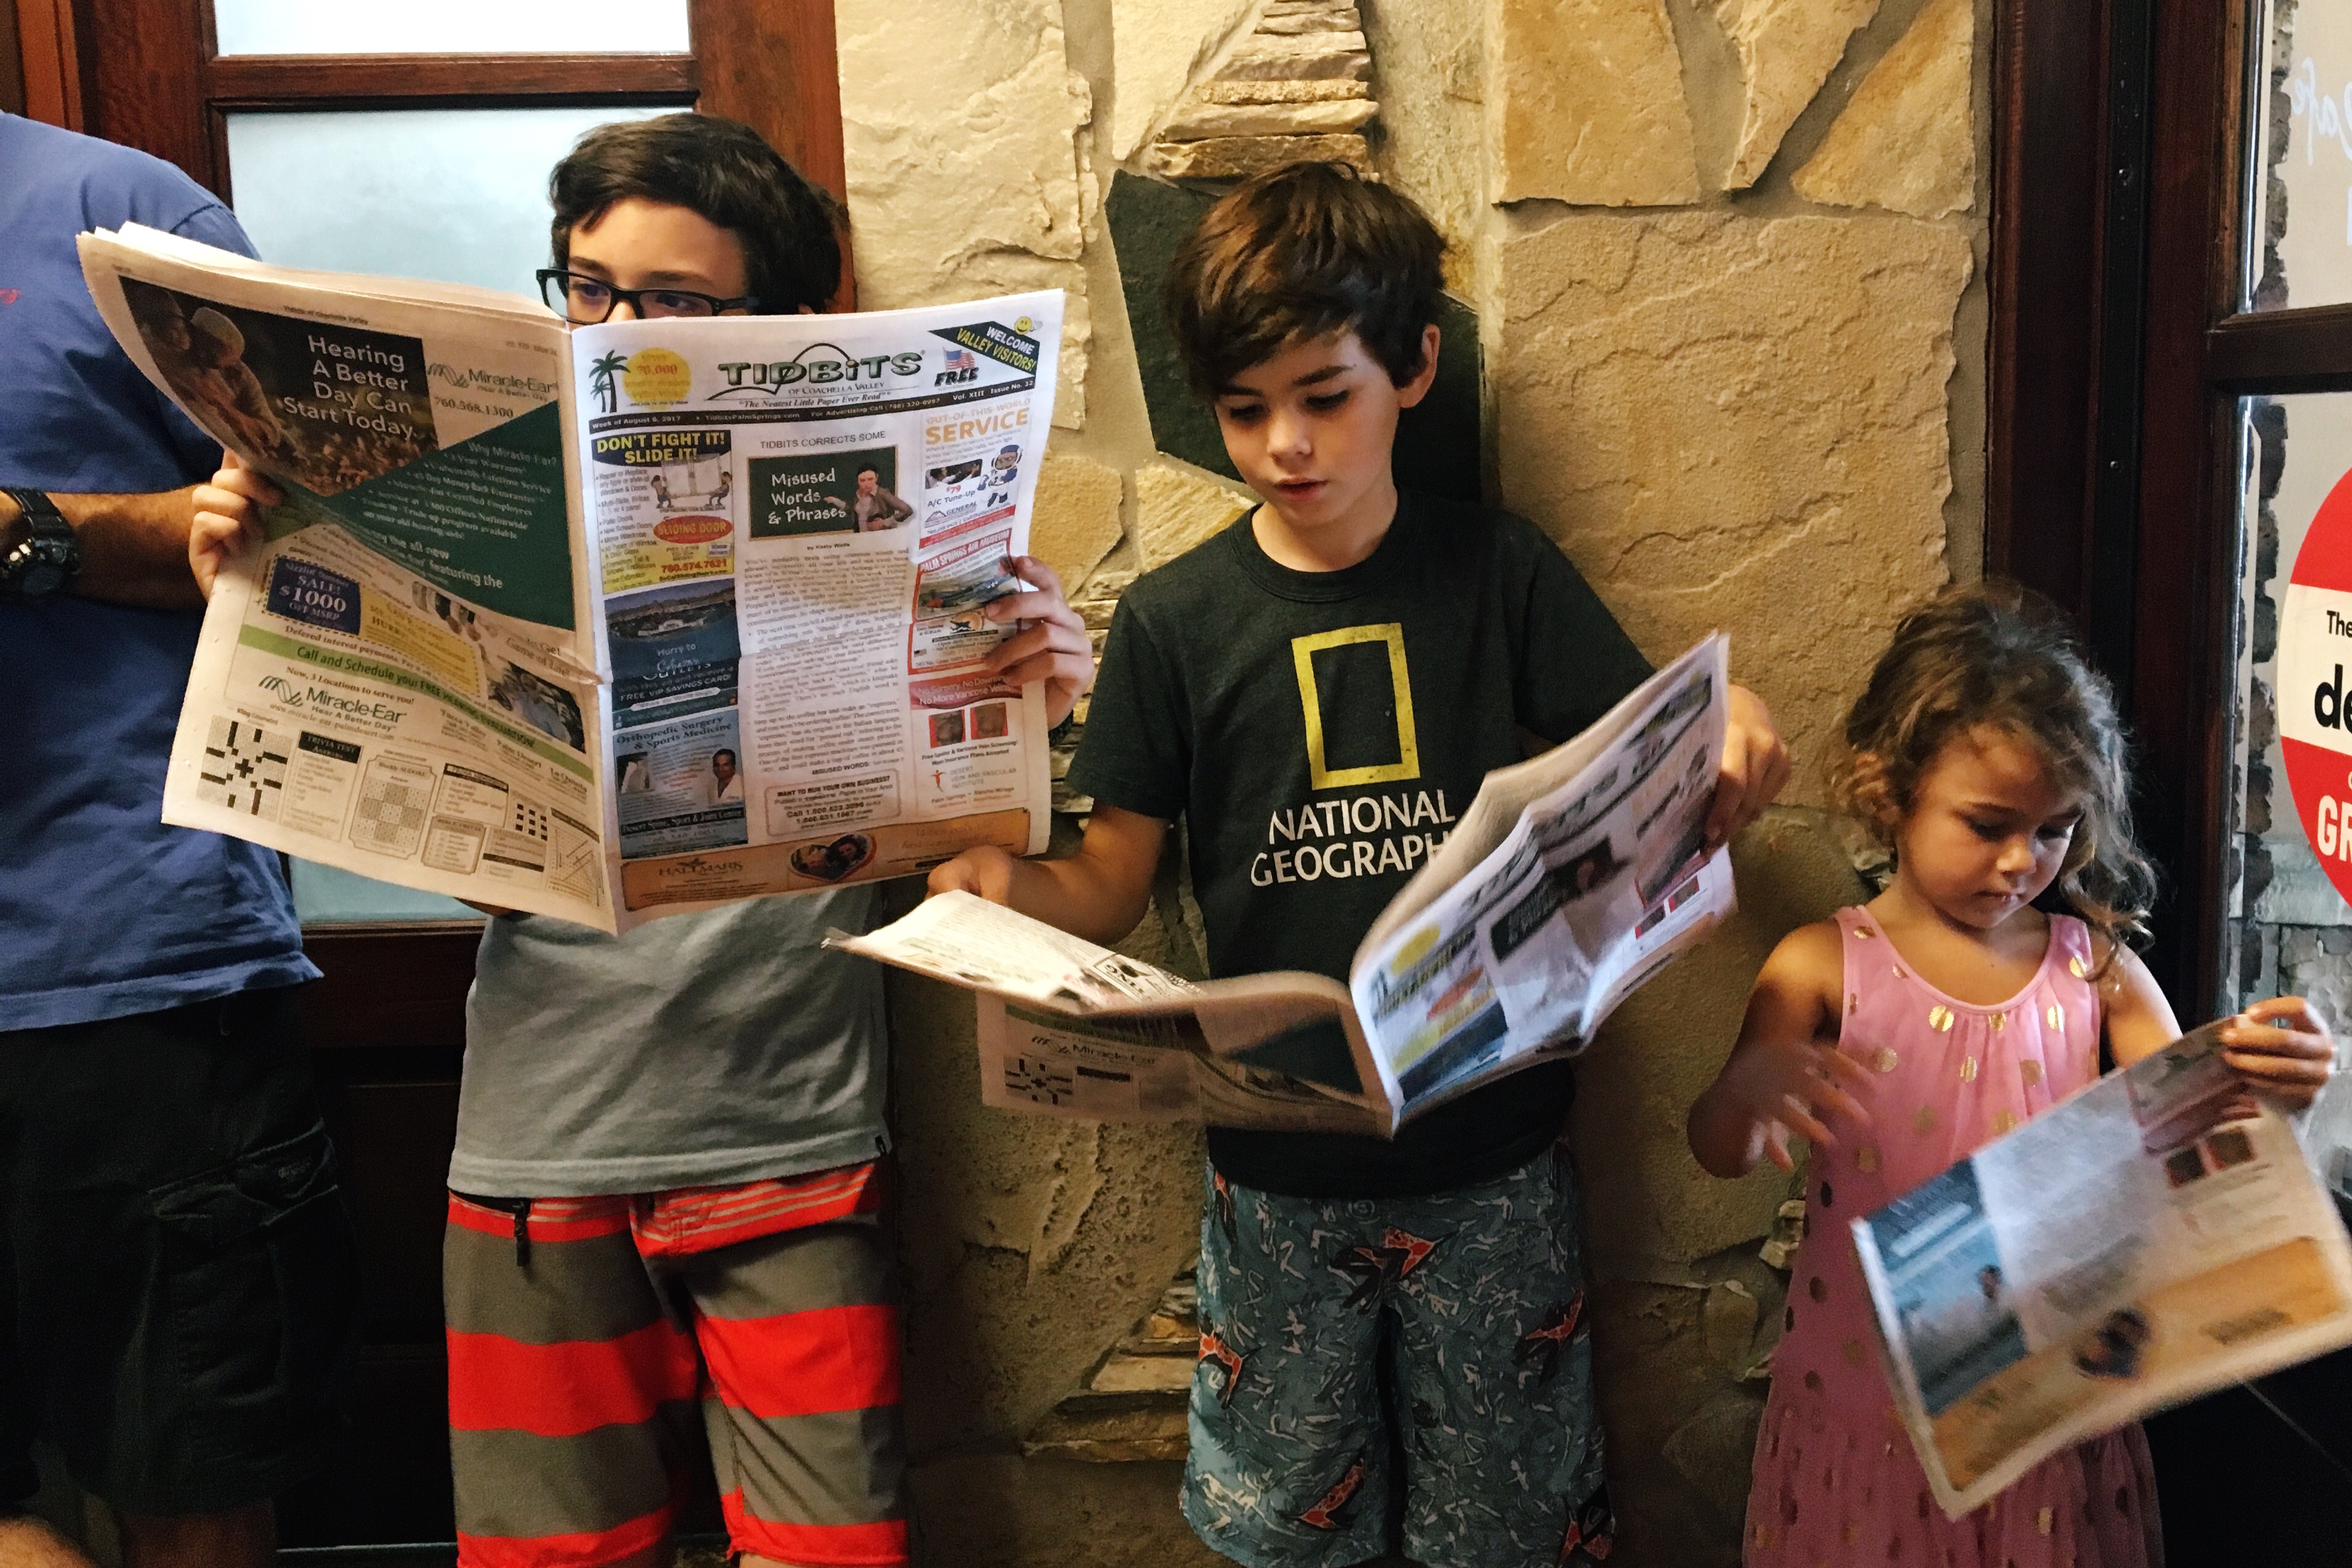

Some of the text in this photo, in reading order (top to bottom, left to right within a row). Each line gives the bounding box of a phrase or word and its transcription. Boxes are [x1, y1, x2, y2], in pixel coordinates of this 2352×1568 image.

[957, 328, 1037, 372] VALLEY VISITORS!
[986, 326, 1035, 355] WELCOME
[308, 335, 405, 372] Hearing
[313, 360, 408, 391] A Better
[934, 367, 980, 387] FREE
[313, 381, 411, 414] Day Can
[802, 385, 853, 395] COACHELLA
[855, 382, 885, 391] VALLEY
[592, 421, 612, 429] Week
[623, 417, 650, 426] August
[826, 406, 868, 416] Advertising
[906, 398, 940, 408] 320-0997
[969, 390, 985, 398] XIII
[990, 386, 1010, 394] Issue
[762, 399, 792, 408] Neatest
[794, 397, 814, 406] Little
[816, 396, 840, 406] Paper
[842, 395, 860, 403] Ever
[284, 395, 417, 441] Start Today.
[925, 408, 1029, 445] SERVICE
[597, 432, 725, 453] DON'T FIGHT IT!
[760, 431, 886, 449] TIDBITS CORRECTS SOME
[624, 448, 697, 464] SLIDE IT!
[771, 468, 836, 487] Misused
[771, 489, 821, 505] Words
[946, 484, 961, 494] $79
[927, 490, 976, 508] A/C Tune-Up
[946, 501, 977, 516] GENERAL
[768, 506, 847, 525] & Phrases
[658, 521, 726, 534] SLIDING DOOR
[409, 542, 423, 553] all
[425, 545, 449, 560] new
[920, 560, 940, 571] PALM
[940, 547, 967, 566] SPRINGS
[968, 541, 979, 553] AIR
[980, 530, 1010, 547] MUSEUM
[429, 561, 503, 589] featuring the
[279, 585, 346, 612] $1000
[323, 638, 357, 650] interest
[656, 645, 684, 656] Hurry
[297, 646, 417, 686] Call and Schedule your
[286, 666, 308, 680] Now,
[318, 675, 359, 692] Locations
[374, 691, 395, 701] serve
[397, 696, 414, 705] you!
[620, 691, 645, 702] FREE
[649, 688, 664, 697] VIP
[666, 680, 703, 693] SAVINGS
[933, 693, 954, 702] More
[955, 688, 989, 699] Varicose
[306, 686, 403, 723] Miracle-Ear
[312, 706, 332, 717] Hear
[345, 714, 371, 726] Better
[374, 722, 393, 732] Day
[617, 716, 723, 744] Orthopedic Surgery
[646, 735, 680, 749] Sports
[683, 723, 731, 738] Medicine
[307, 735, 356, 753] TRIVIA TEST
[945, 755, 969, 763] Insurance
[812, 766, 842, 774] MISUSED
[982, 768, 1017, 776] VASCULAR
[857, 776, 890, 786] BUSINESS?
[951, 779, 985, 788] INSTITUTE
[786, 810, 803, 818] Call
[1269, 789, 1456, 845] NATIONAL
[1251, 832, 1448, 887] GEOGRAPH
